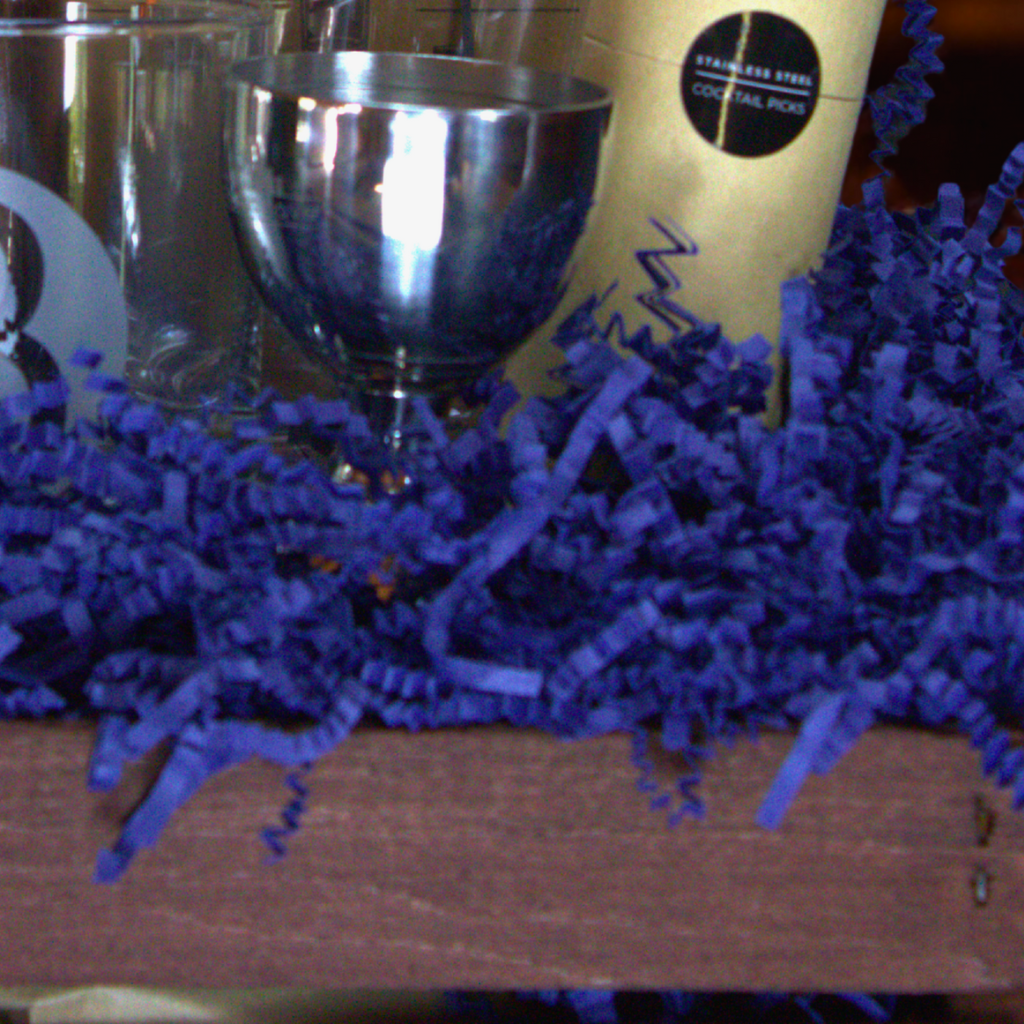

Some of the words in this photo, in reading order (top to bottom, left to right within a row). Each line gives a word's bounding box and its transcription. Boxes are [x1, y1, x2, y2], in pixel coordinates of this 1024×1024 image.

[695, 55, 772, 80] STAINLESS
[775, 70, 813, 87] STEEL
[767, 96, 806, 115] PICKS
